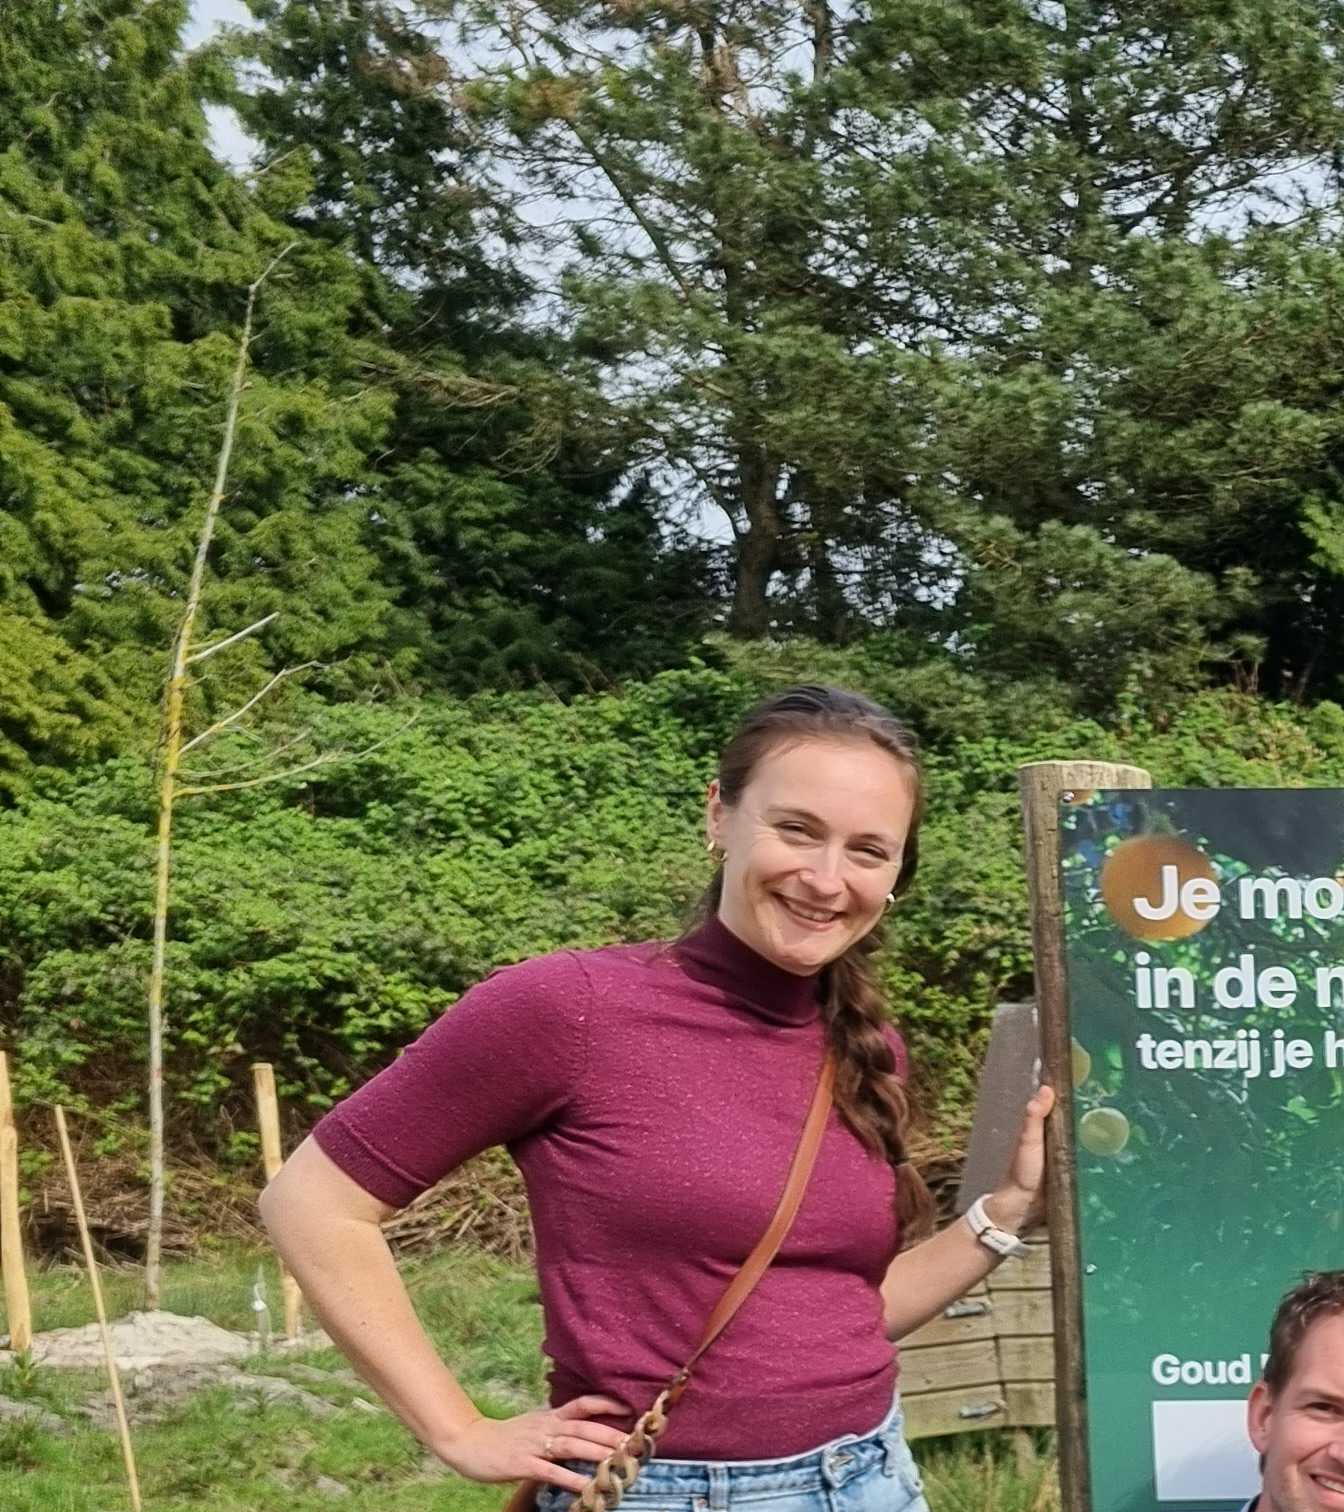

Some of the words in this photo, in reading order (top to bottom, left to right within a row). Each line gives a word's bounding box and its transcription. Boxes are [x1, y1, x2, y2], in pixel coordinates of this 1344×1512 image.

[1133, 864, 1220, 920] Je
[1135, 951, 1194, 1009] in
[1214, 953, 1297, 1008] de
[1136, 1029, 1262, 1078] tenzij
[1270, 1029, 1313, 1078] je
[1152, 1353, 1252, 1385] Goud
